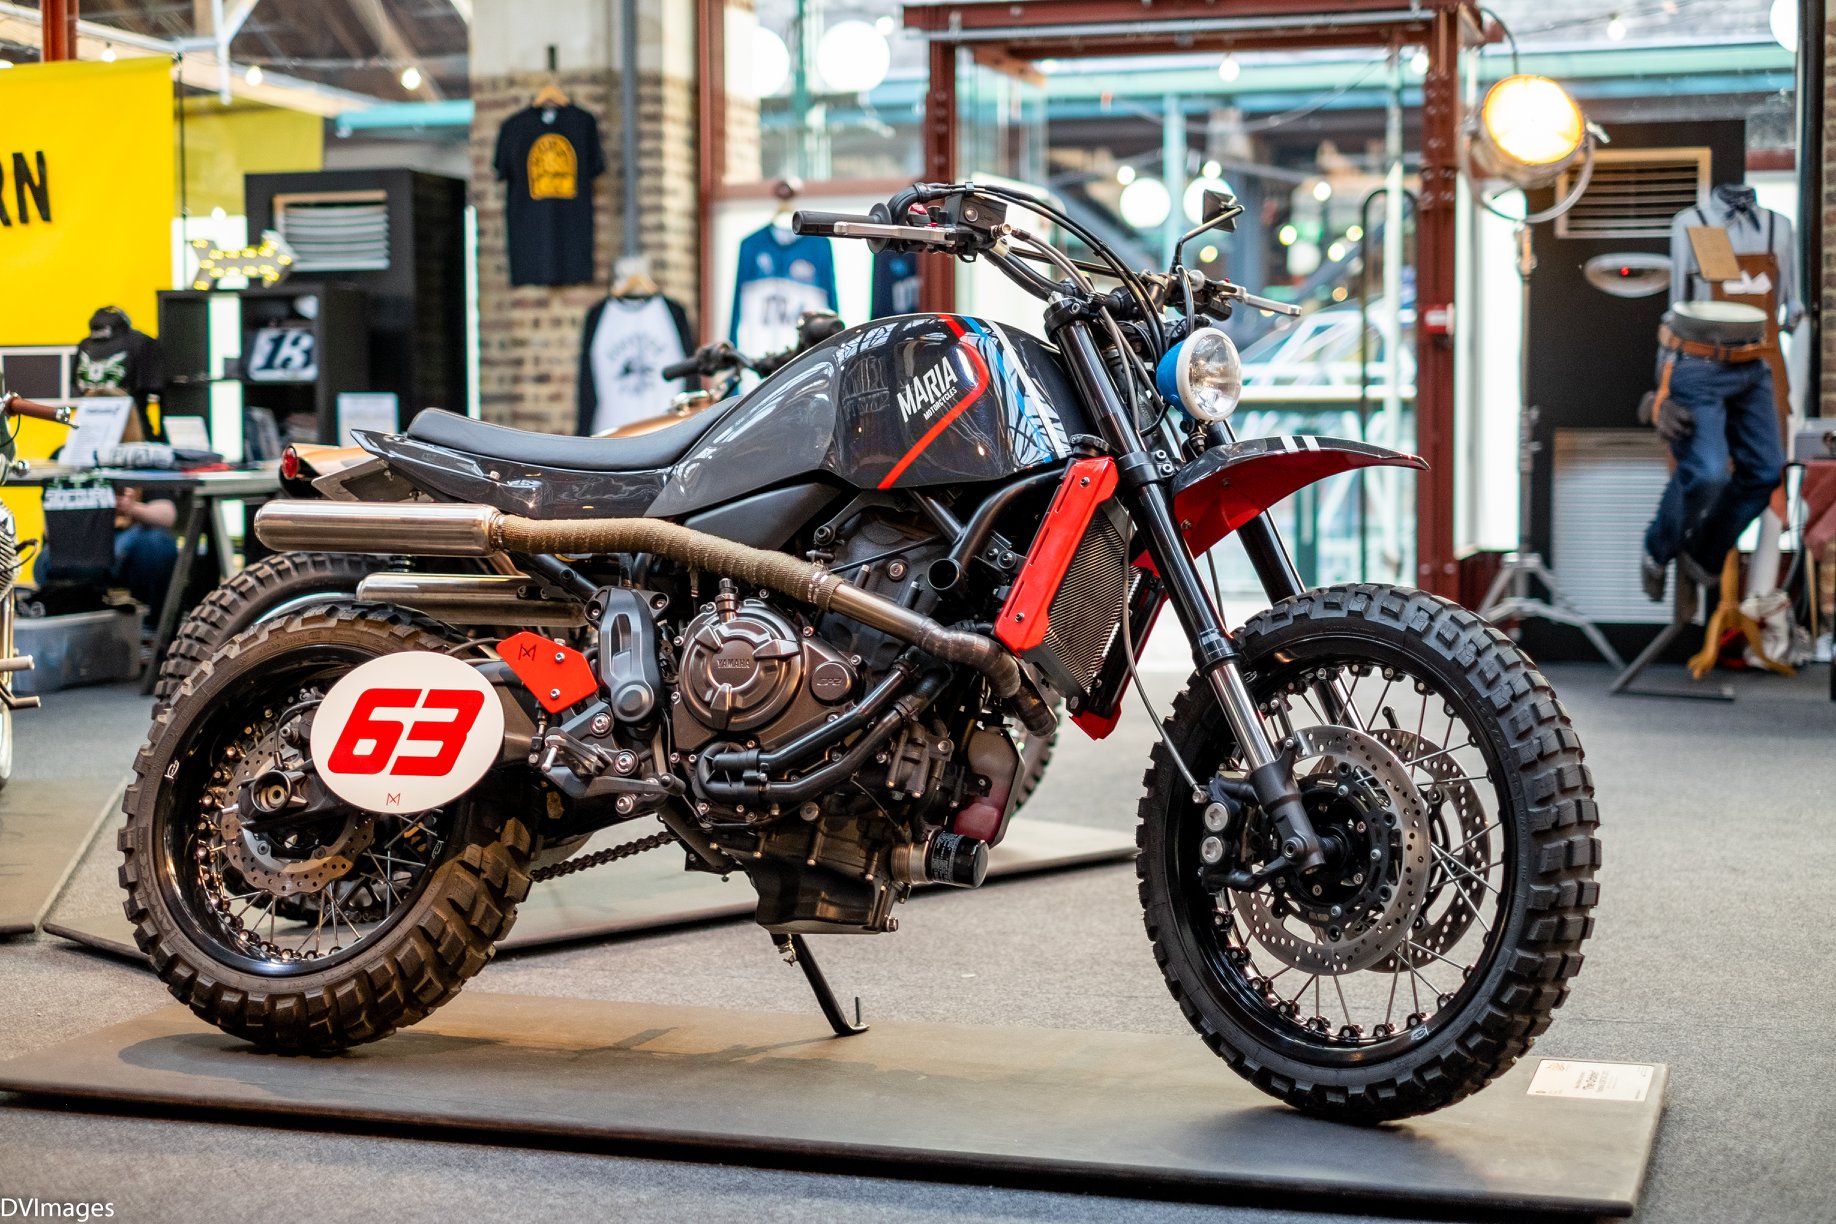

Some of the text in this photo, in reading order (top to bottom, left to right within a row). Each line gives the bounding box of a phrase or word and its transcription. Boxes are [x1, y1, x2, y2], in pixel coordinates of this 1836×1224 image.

[896, 355, 958, 423] MARIA
[923, 386, 958, 421] MOTORCYCLES
[717, 658, 751, 669] YAMAHA
[327, 688, 485, 777] 63
